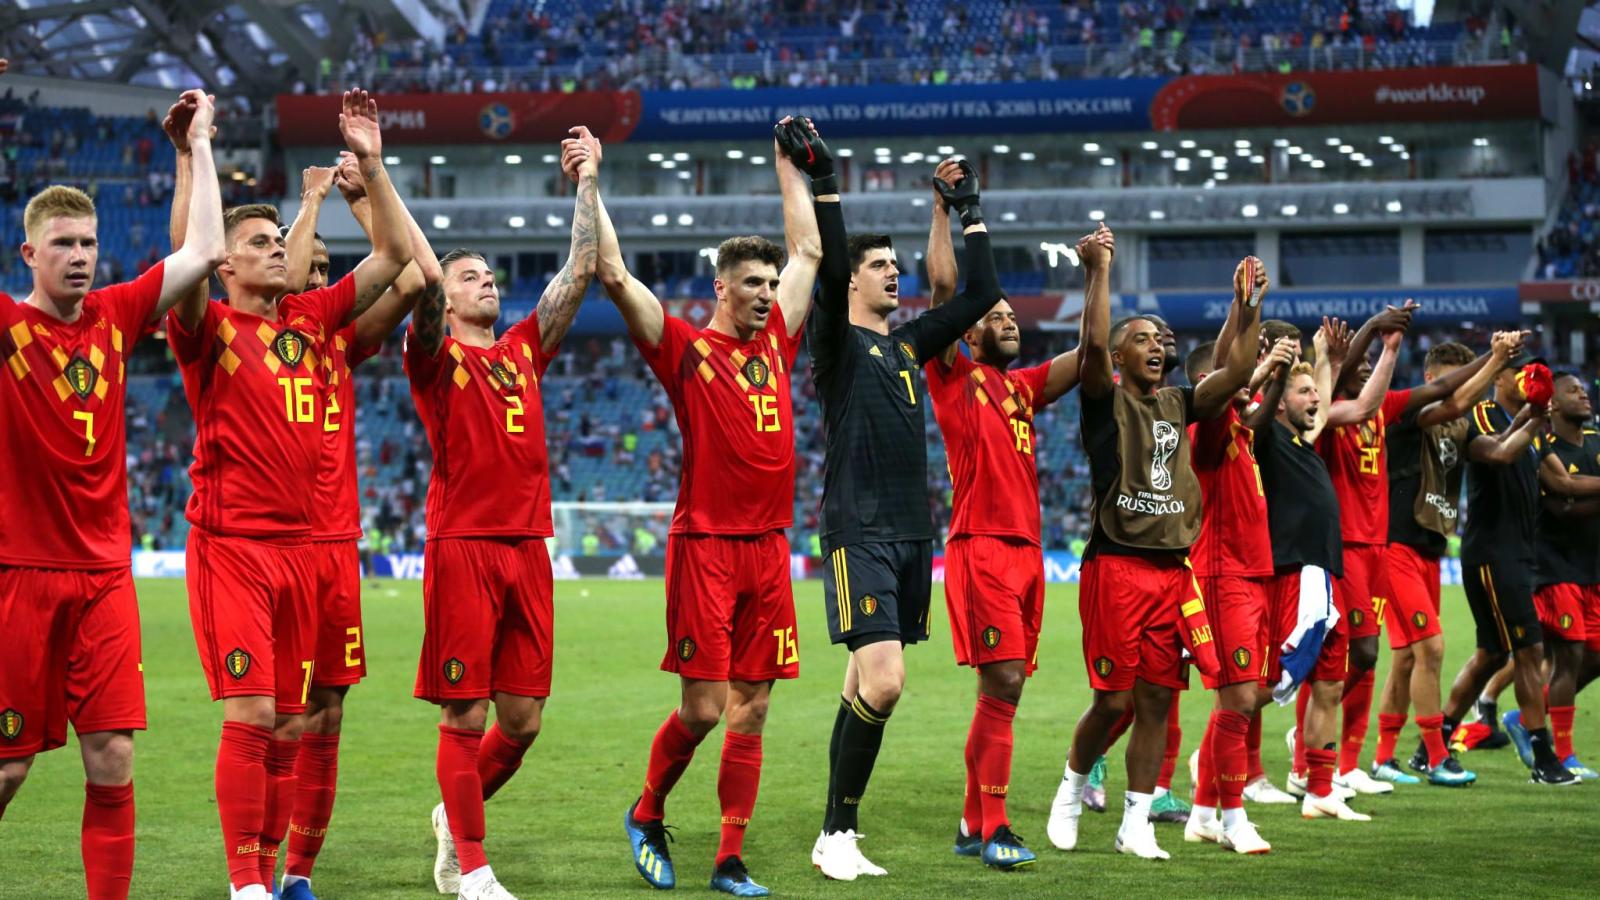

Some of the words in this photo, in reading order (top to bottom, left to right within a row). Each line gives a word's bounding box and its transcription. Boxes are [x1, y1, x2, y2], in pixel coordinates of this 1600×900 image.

[660, 107, 770, 124] ЧЕМПИОНАТ
[833, 103, 860, 119] ПО
[864, 101, 949, 119] ФУТБОЛУ
[952, 100, 992, 117] FIFA
[995, 99, 1036, 116] 2018
[1054, 96, 1132, 114] РОССИИ
[1375, 82, 1485, 105] #worldcup
[378, 110, 425, 129] ОЧИ
[1295, 299, 1367, 316] WORLD
[1412, 297, 1490, 316] RUSSIA
[278, 377, 314, 423] 16
[899, 370, 916, 405] 1
[504, 395, 525, 433] 2
[749, 394, 781, 432] 15
[73, 410, 96, 457] 7
[1010, 418, 1031, 455] 19
[1137, 491, 1152, 499] FIFA
[345, 626, 361, 667] 2
[773, 625, 799, 666] 15
